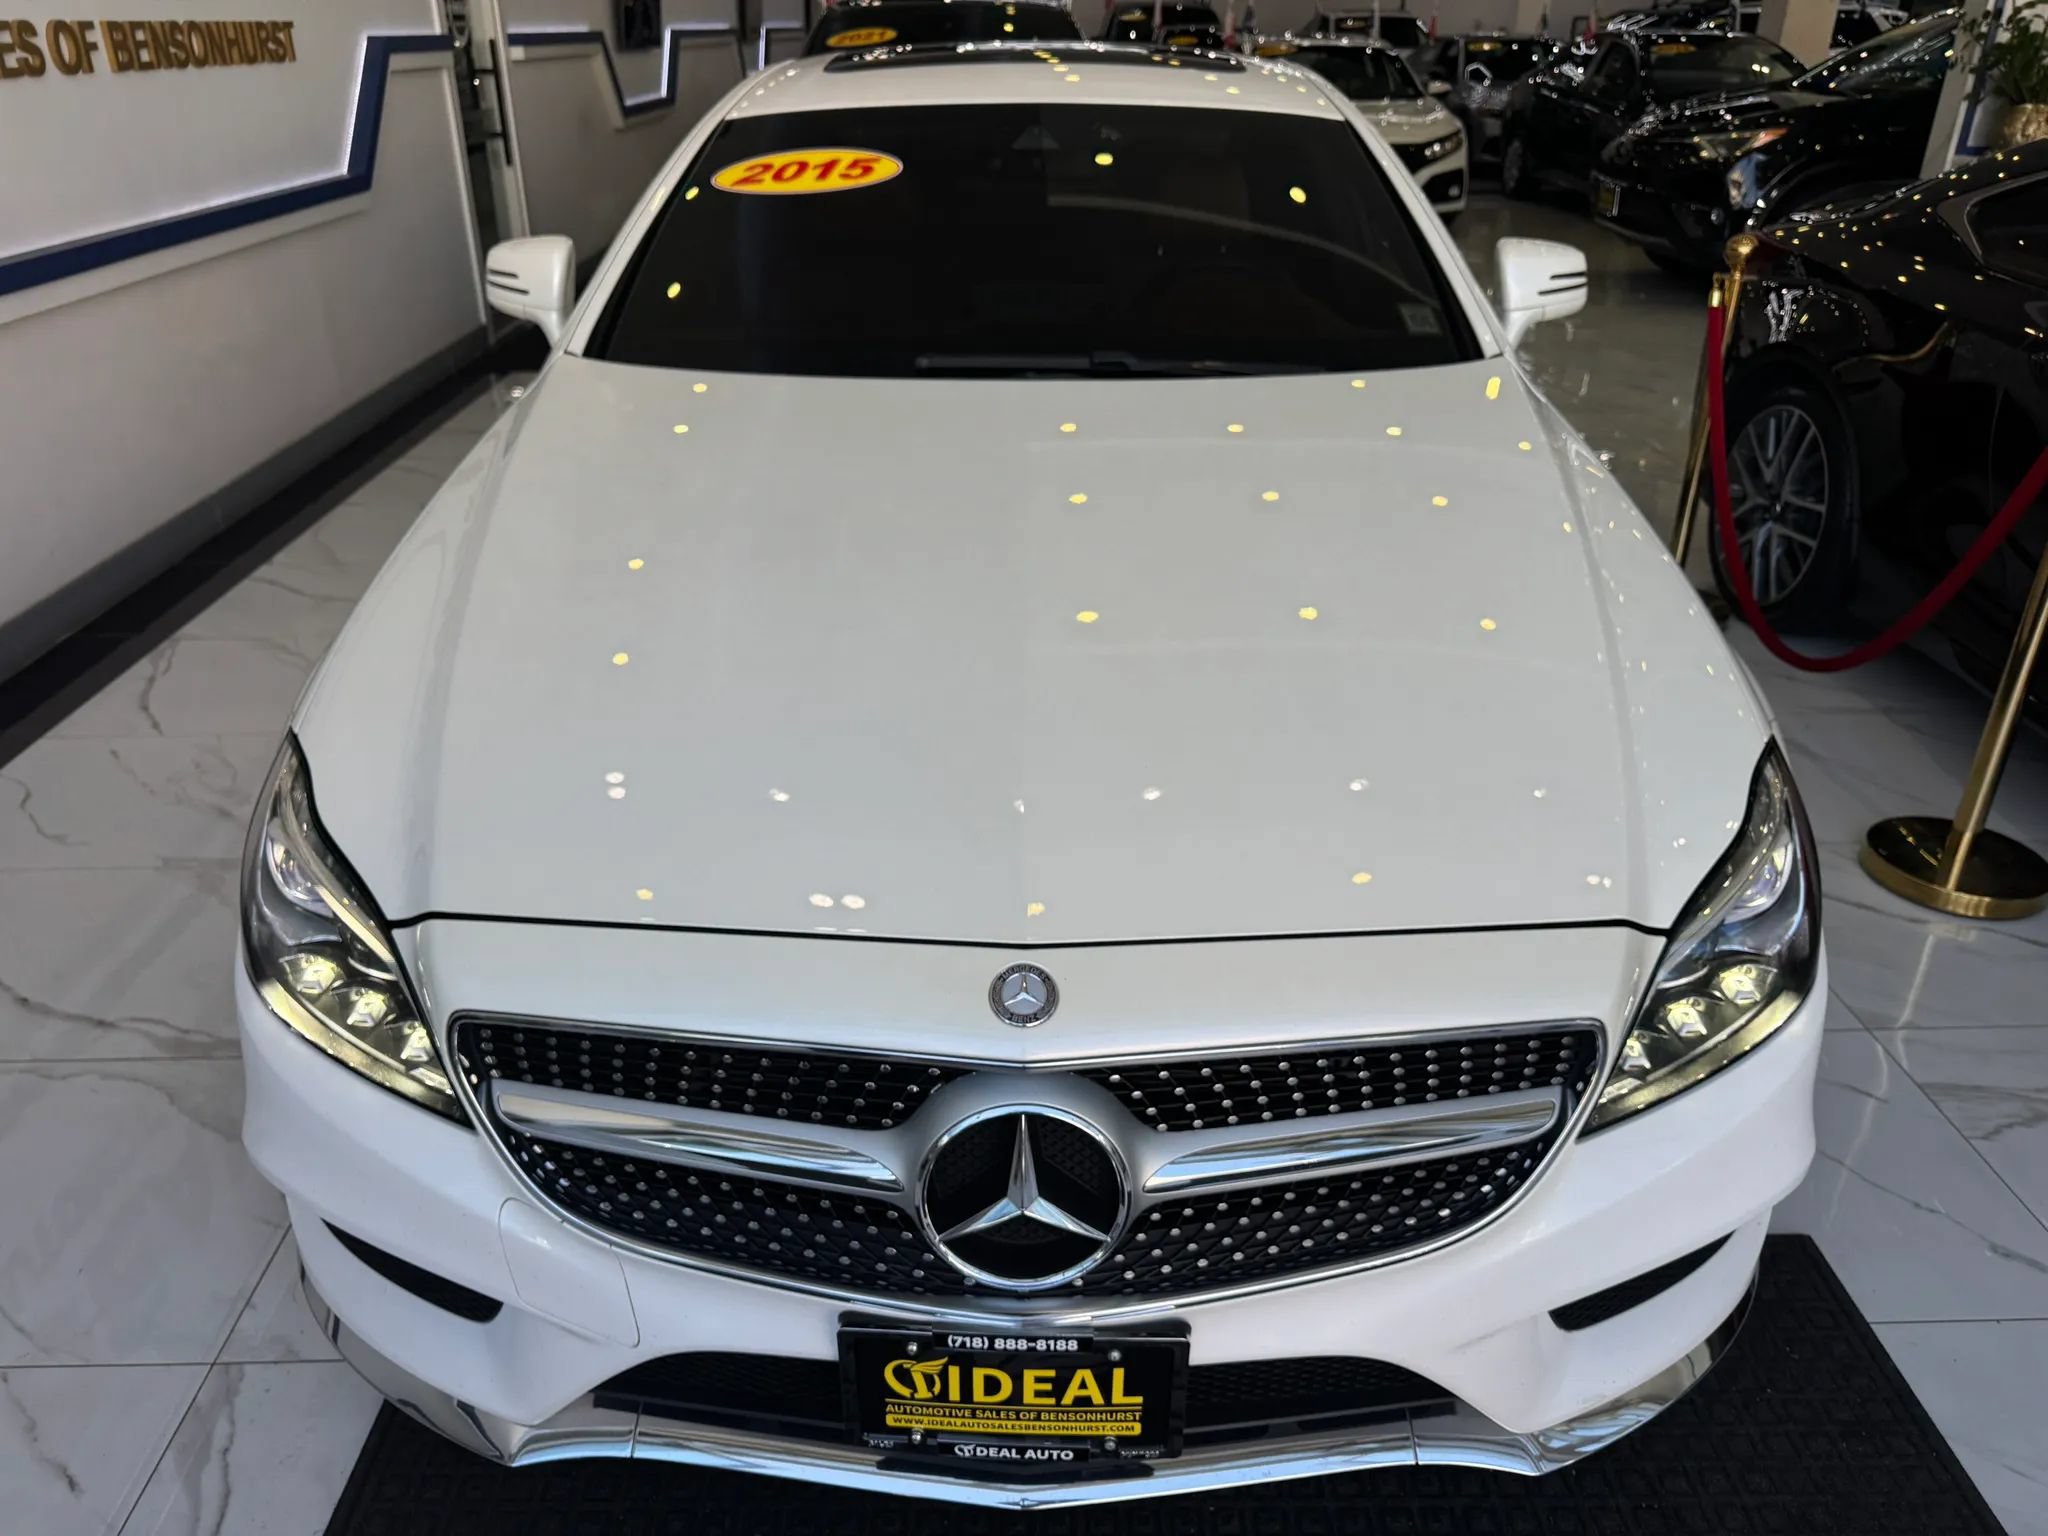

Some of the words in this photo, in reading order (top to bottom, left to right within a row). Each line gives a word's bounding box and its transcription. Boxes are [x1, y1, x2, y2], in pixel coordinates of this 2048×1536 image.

[46, 19, 99, 75] OF
[99, 20, 297, 73] BENSONHURST
[731, 156, 882, 187] 2015
[947, 1334, 989, 1349] (718)
[993, 1337, 1079, 1351] 888-8188
[885, 1404, 973, 1418] AUTOMOTIVE
[975, 1409, 1017, 1420] SALES
[1019, 1411, 1038, 1420] OF
[1040, 1411, 1143, 1422] BENSONHURST
[892, 1415, 1135, 1433] WWW.IDEALAUTOSALESBENSONHURST.COM
[1023, 1448, 1075, 1461] AUTO
